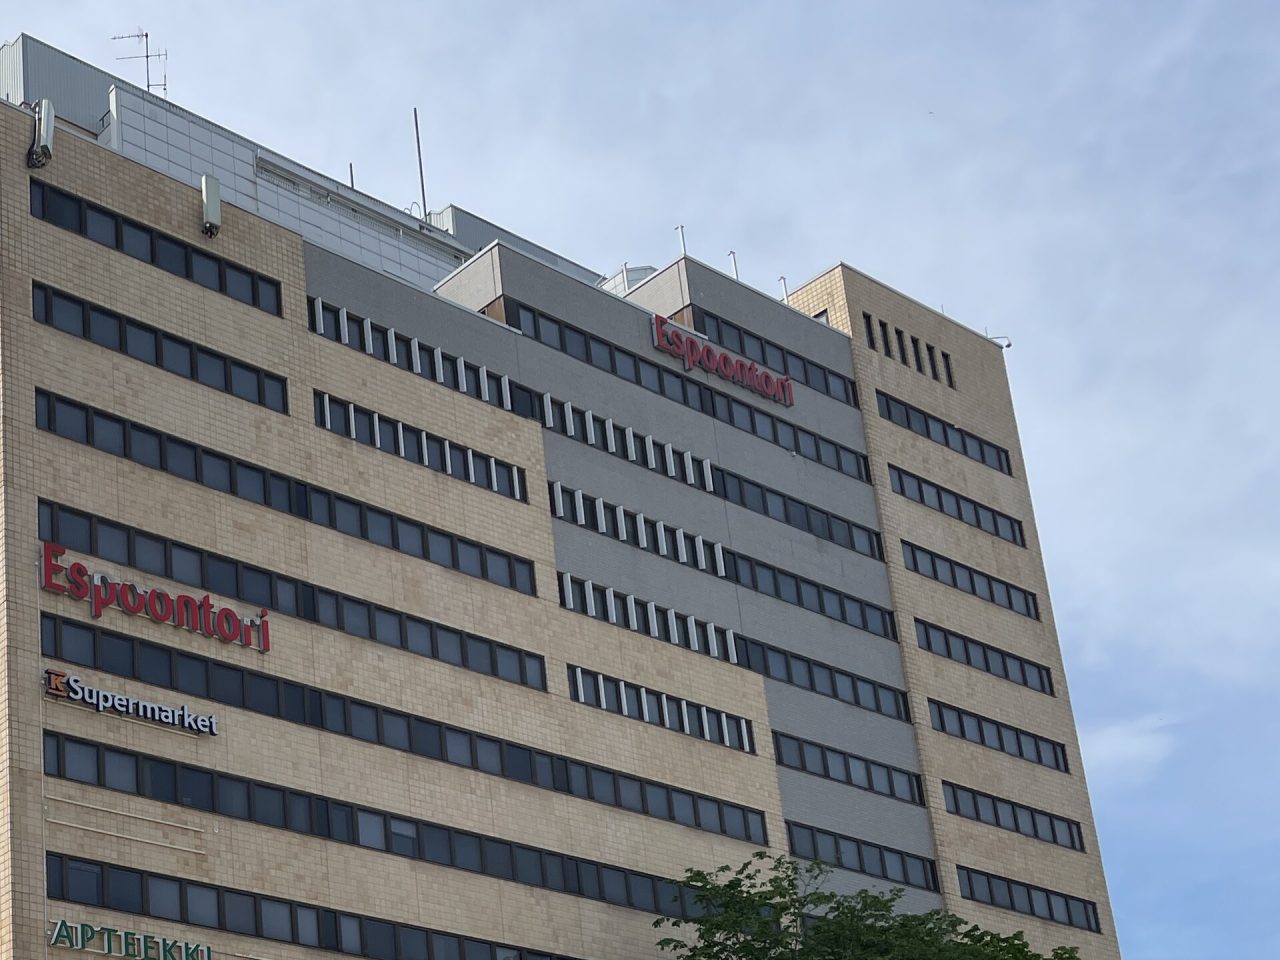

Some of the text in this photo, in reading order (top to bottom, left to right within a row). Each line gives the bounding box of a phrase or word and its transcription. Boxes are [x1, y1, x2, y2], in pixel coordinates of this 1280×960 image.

[653, 314, 794, 407] Espoontori
[43, 542, 270, 652] Espoontori
[68, 675, 218, 736] Supermarket
